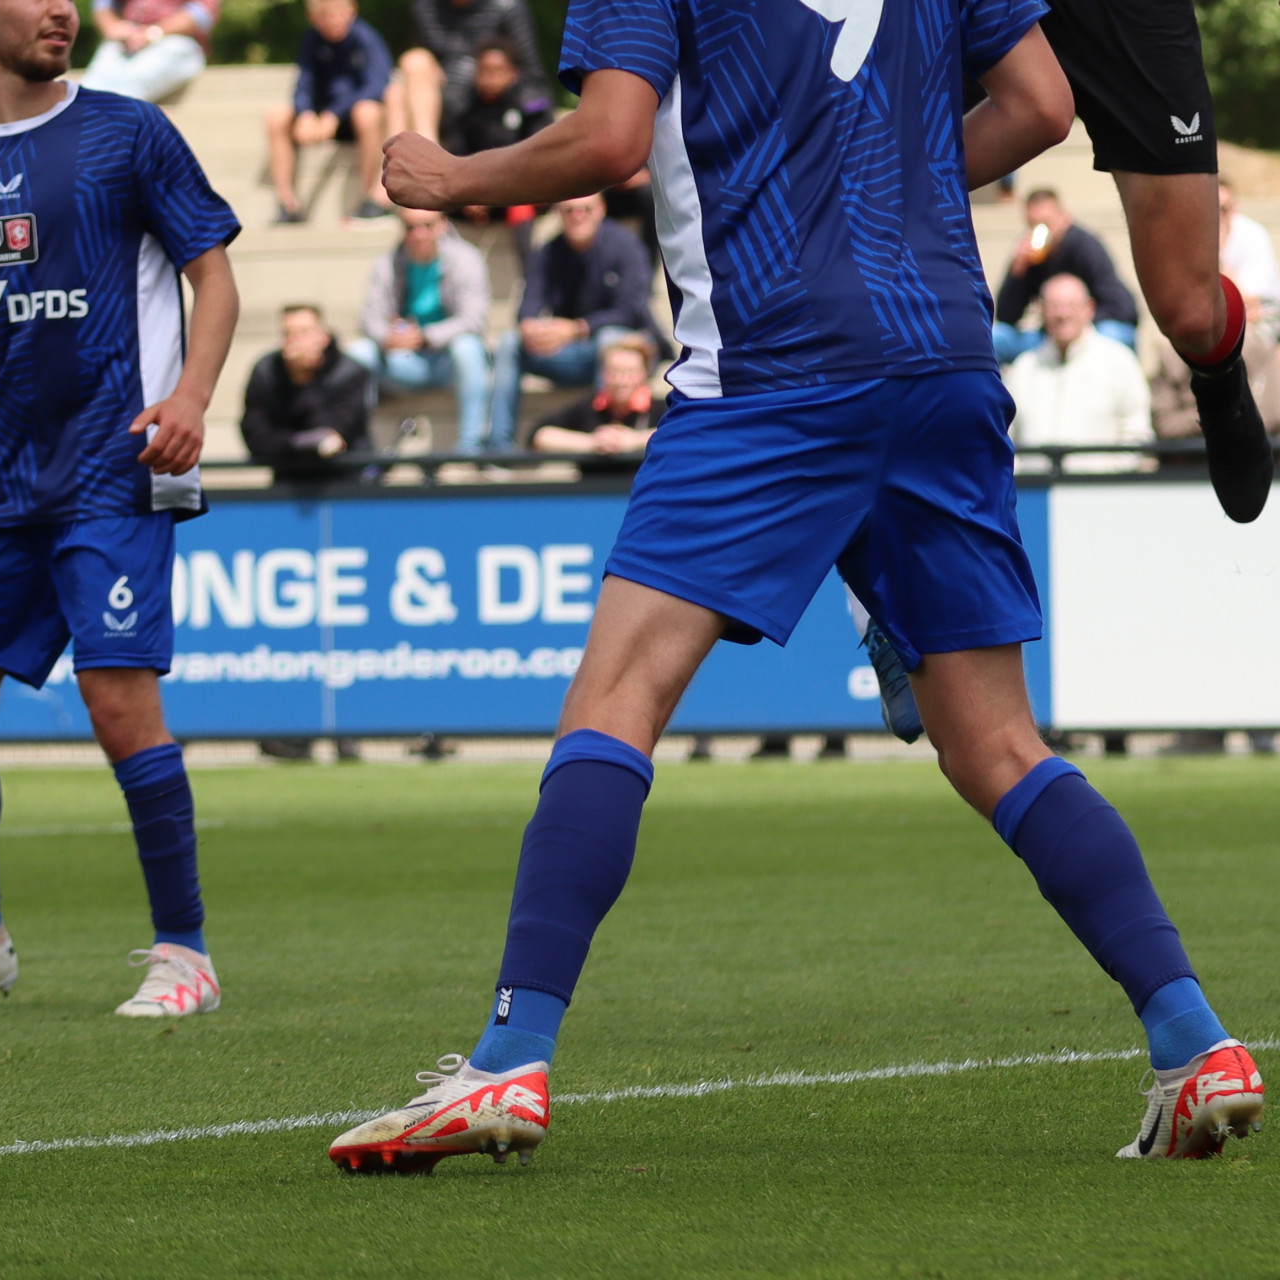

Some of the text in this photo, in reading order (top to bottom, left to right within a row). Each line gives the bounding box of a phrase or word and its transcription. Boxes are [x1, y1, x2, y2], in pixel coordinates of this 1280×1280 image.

[7, 288, 89, 323] DFDS
[108, 575, 134, 610] 6
[172, 547, 369, 629] NGE
[388, 546, 459, 626] &
[477, 544, 594, 625] DE
